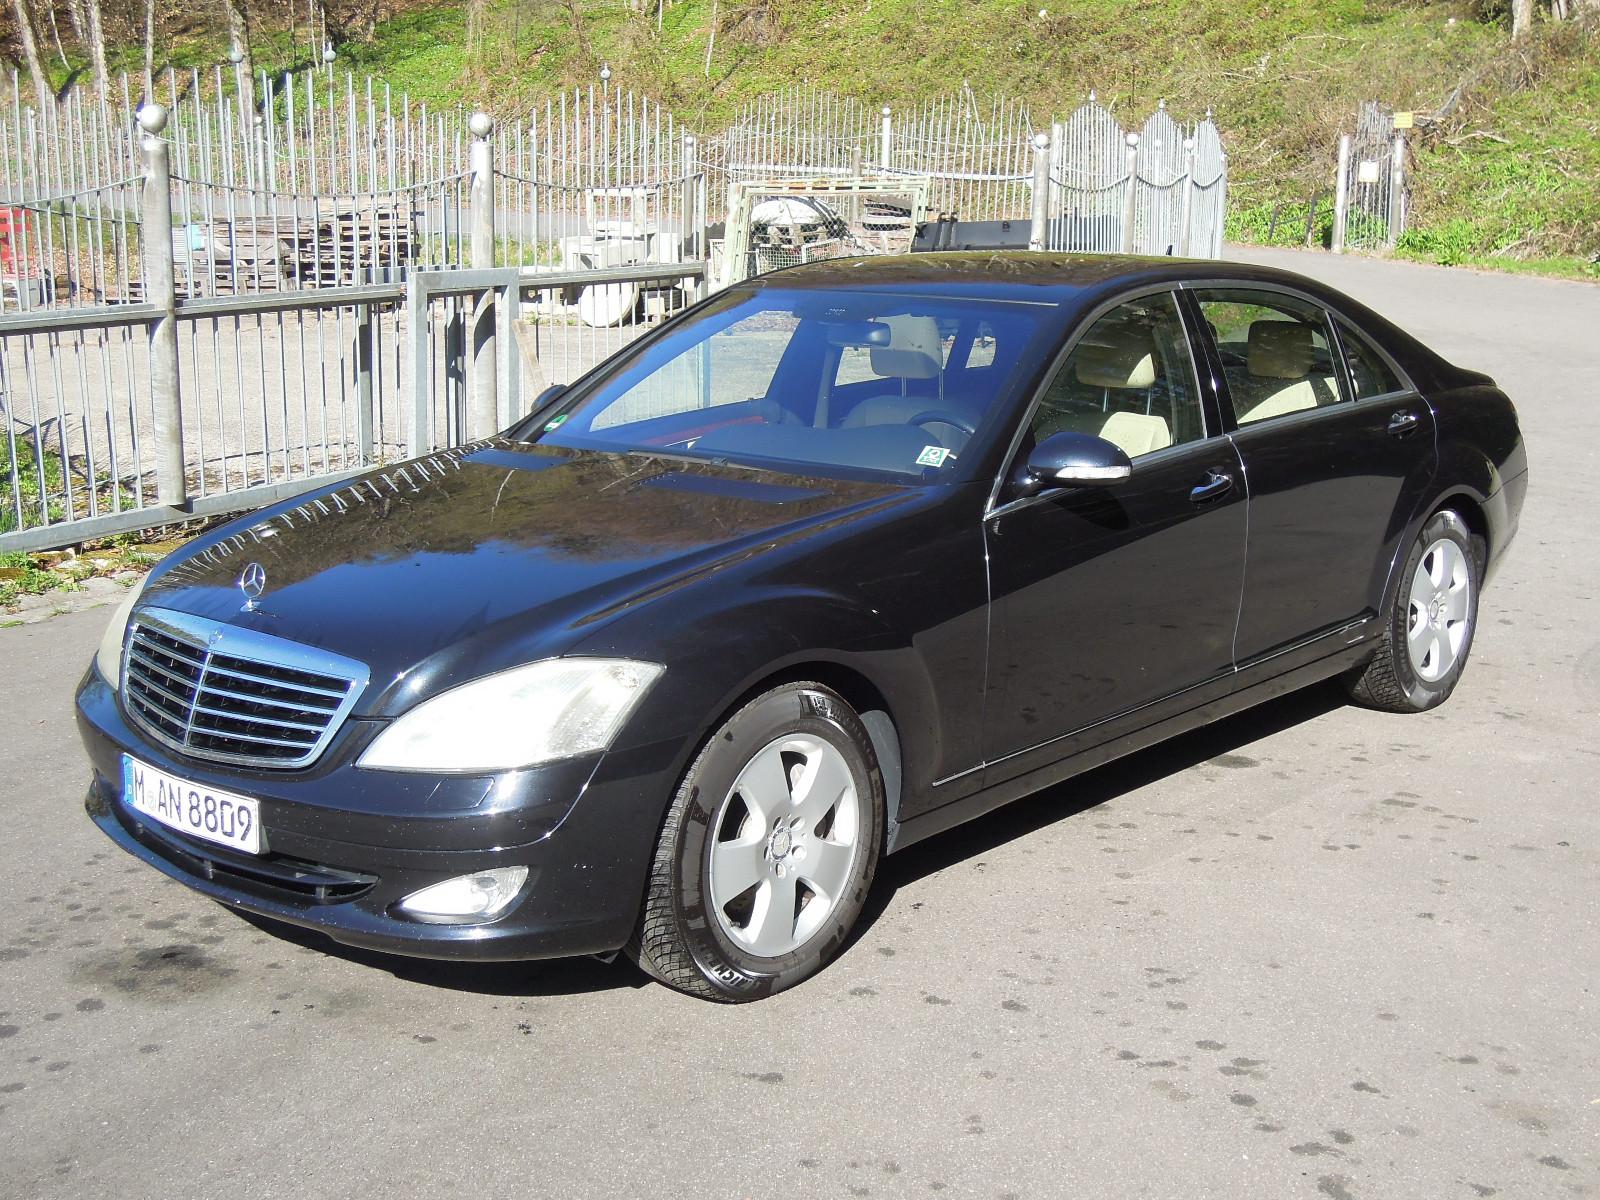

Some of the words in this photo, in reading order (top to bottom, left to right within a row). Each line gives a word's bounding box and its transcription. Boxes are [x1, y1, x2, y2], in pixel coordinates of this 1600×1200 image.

[134, 766, 145, 805] M
[158, 778, 182, 822] AN
[188, 791, 252, 841] 8809
